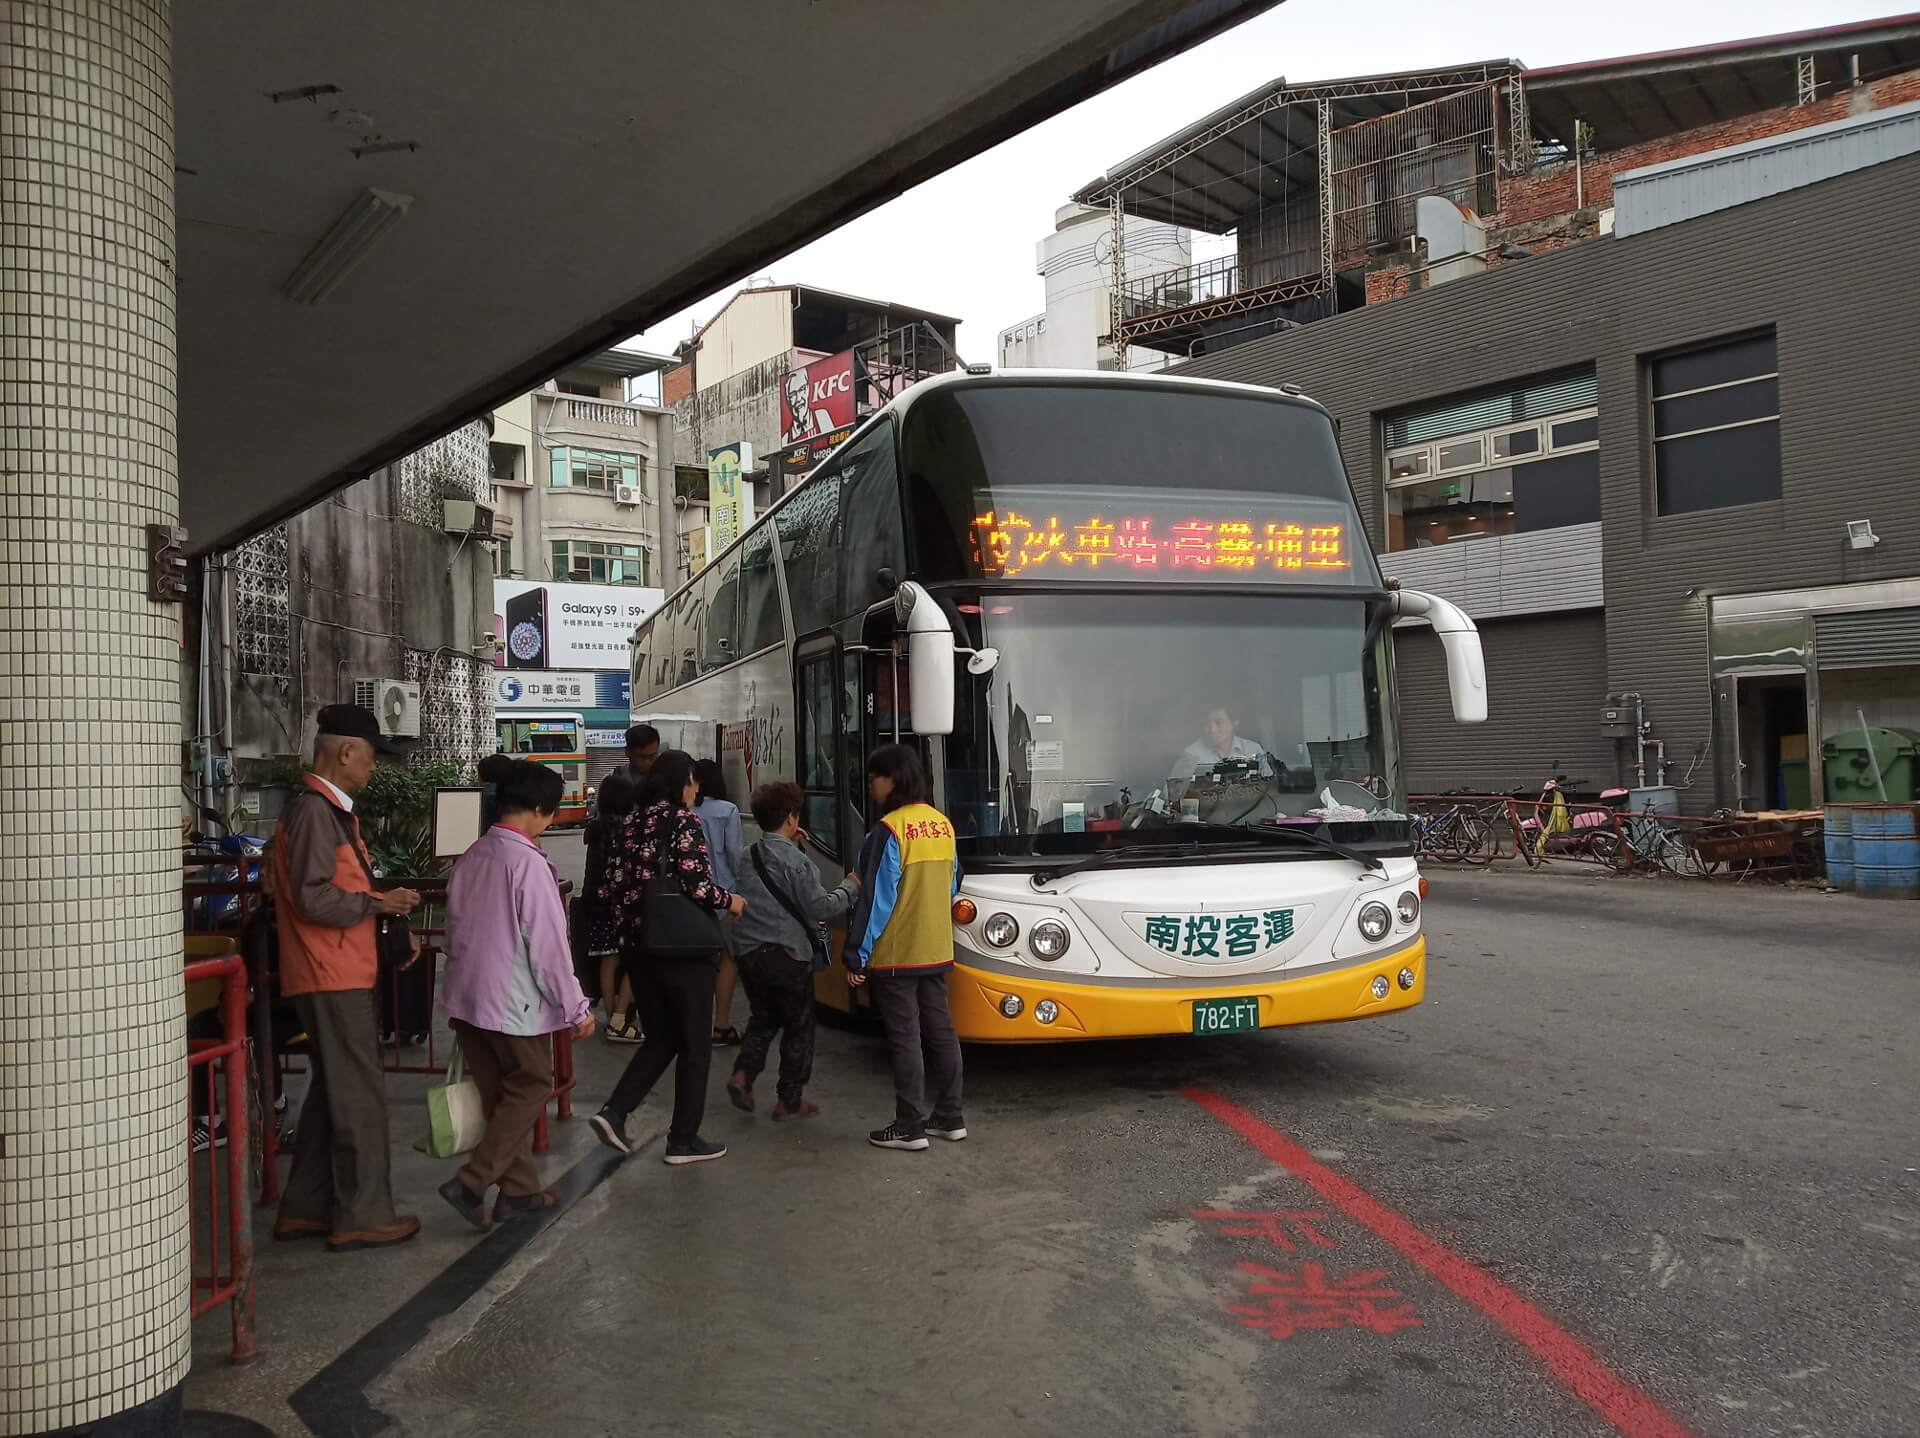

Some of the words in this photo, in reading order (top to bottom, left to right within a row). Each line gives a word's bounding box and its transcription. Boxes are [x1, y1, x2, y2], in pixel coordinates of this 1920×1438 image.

[812, 370, 851, 403] KFC
[561, 603, 602, 618] Galaxy
[604, 604, 617, 615] S9
[628, 606, 645, 616] S9+
[528, 684, 581, 696] 中華電信
[722, 725, 744, 751] Taiwan
[1145, 909, 1295, 957] 南投客運
[1195, 1004, 1257, 1031] 782-FT
